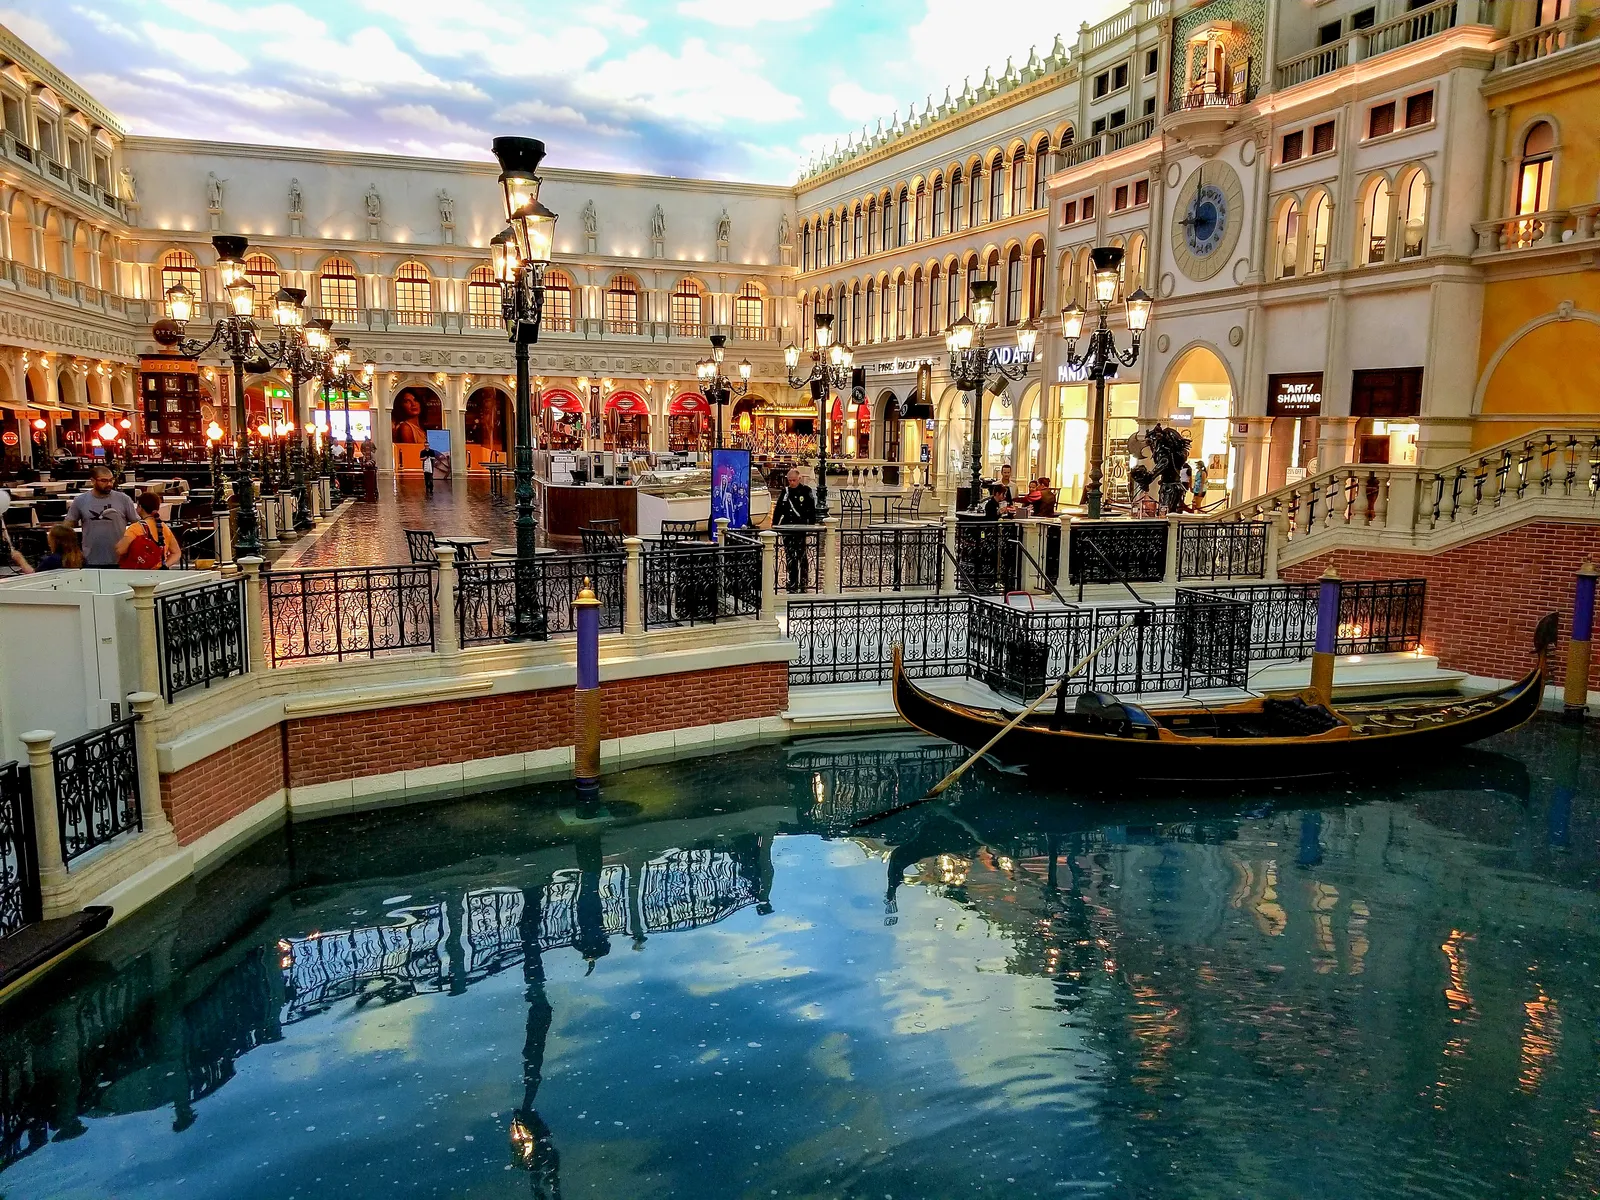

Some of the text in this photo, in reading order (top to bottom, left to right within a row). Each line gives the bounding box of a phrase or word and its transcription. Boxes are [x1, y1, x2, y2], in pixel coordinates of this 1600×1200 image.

[149, 362, 180, 371] OTTO
[1287, 383, 1308, 394] ART
[1277, 393, 1322, 403] SHAVING
